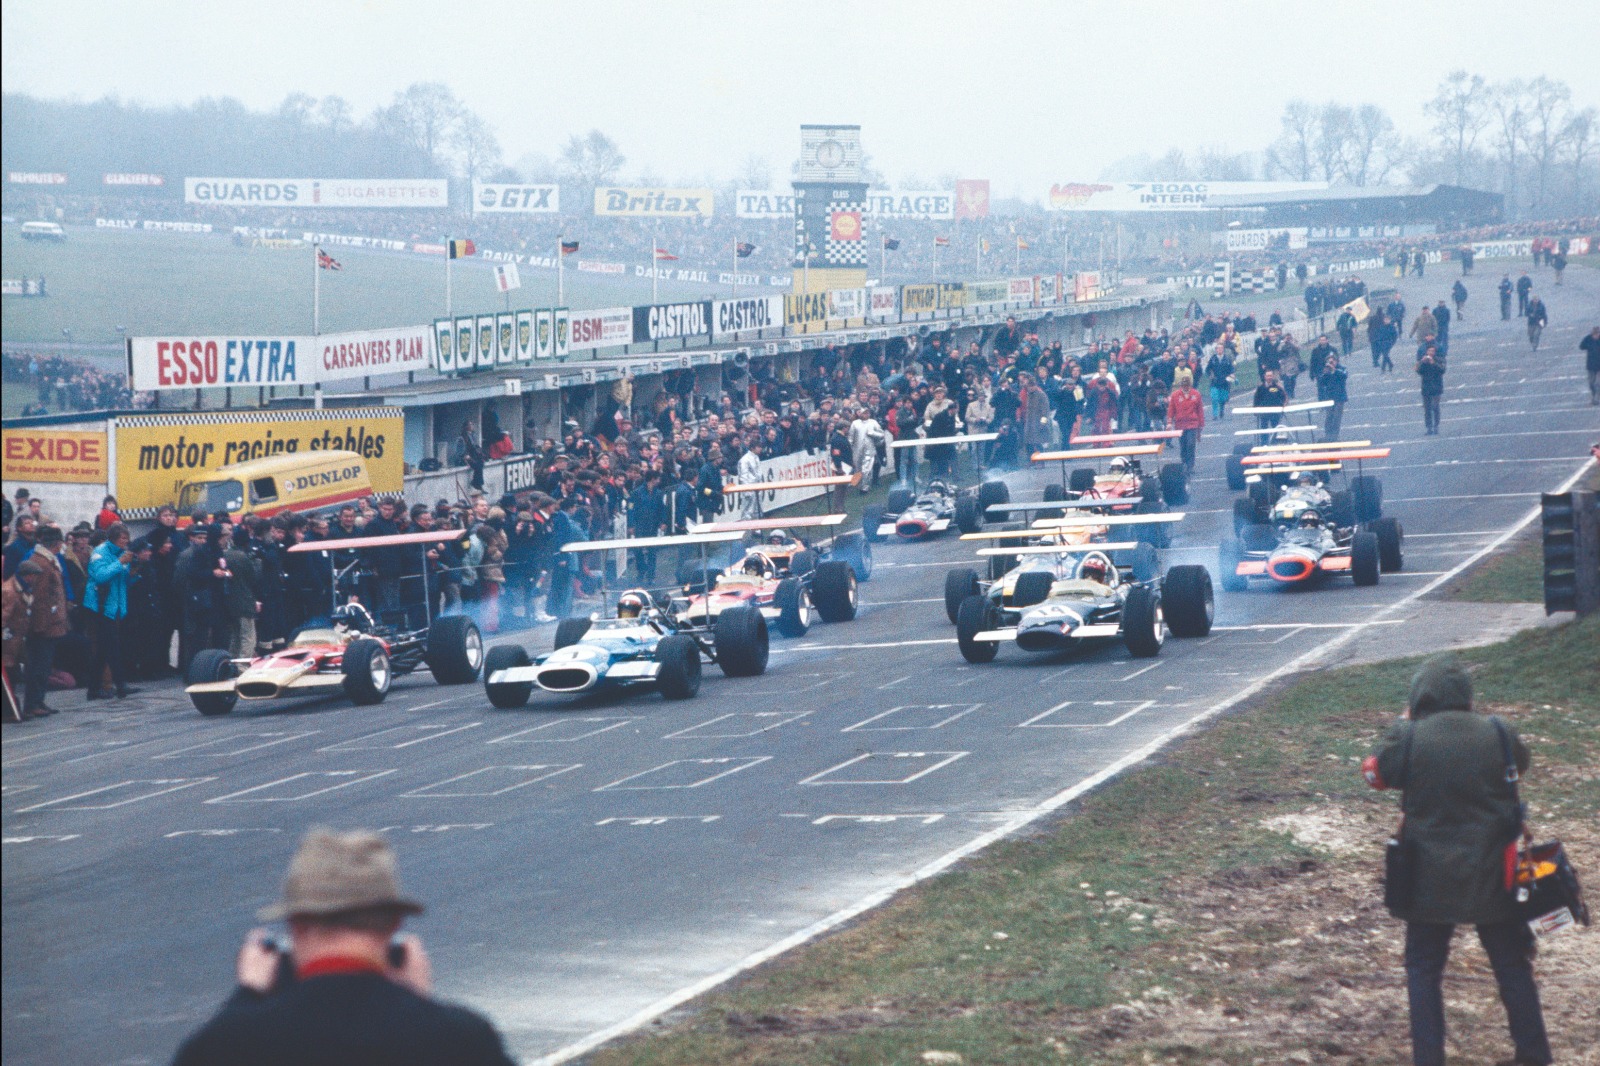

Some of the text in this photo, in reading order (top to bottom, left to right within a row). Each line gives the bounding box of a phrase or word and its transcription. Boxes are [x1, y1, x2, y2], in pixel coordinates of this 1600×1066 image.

[194, 182, 440, 201] GUARDS CIGARETTES
[832, 190, 850, 199] CLASS
[1151, 183, 1208, 193] BOAC
[501, 187, 553, 208] GTX
[606, 189, 702, 212] Britax
[740, 195, 795, 214] TAK
[96, 218, 213, 232] DAILY EXPRESS
[796, 219, 805, 231] 2
[796, 235, 804, 246] 3
[1229, 232, 1266, 247] GUARDS
[483, 250, 526, 263] DAILY
[635, 265, 709, 283] DAILY MAIL
[1328, 257, 1385, 275] CHAMPION
[719, 298, 771, 332] CASTROL
[788, 292, 826, 324] LUCAS
[572, 318, 603, 343] BSM
[648, 303, 708, 340] CASTROL
[323, 340, 391, 371] CARSAVERS
[395, 336, 424, 362] PLAN
[681, 357, 688, 367] 6
[712, 353, 719, 363] 7
[157, 340, 297, 386] ESSO EXTRA
[620, 367, 627, 377] 4
[652, 362, 659, 372] 5
[552, 376, 559, 387] 2
[585, 371, 592, 382] 3
[510, 381, 517, 393] 1
[5, 437, 100, 462] EXIDE
[138, 435, 214, 471] motor
[309, 425, 386, 459] stables
[296, 465, 361, 490] DUNLOP
